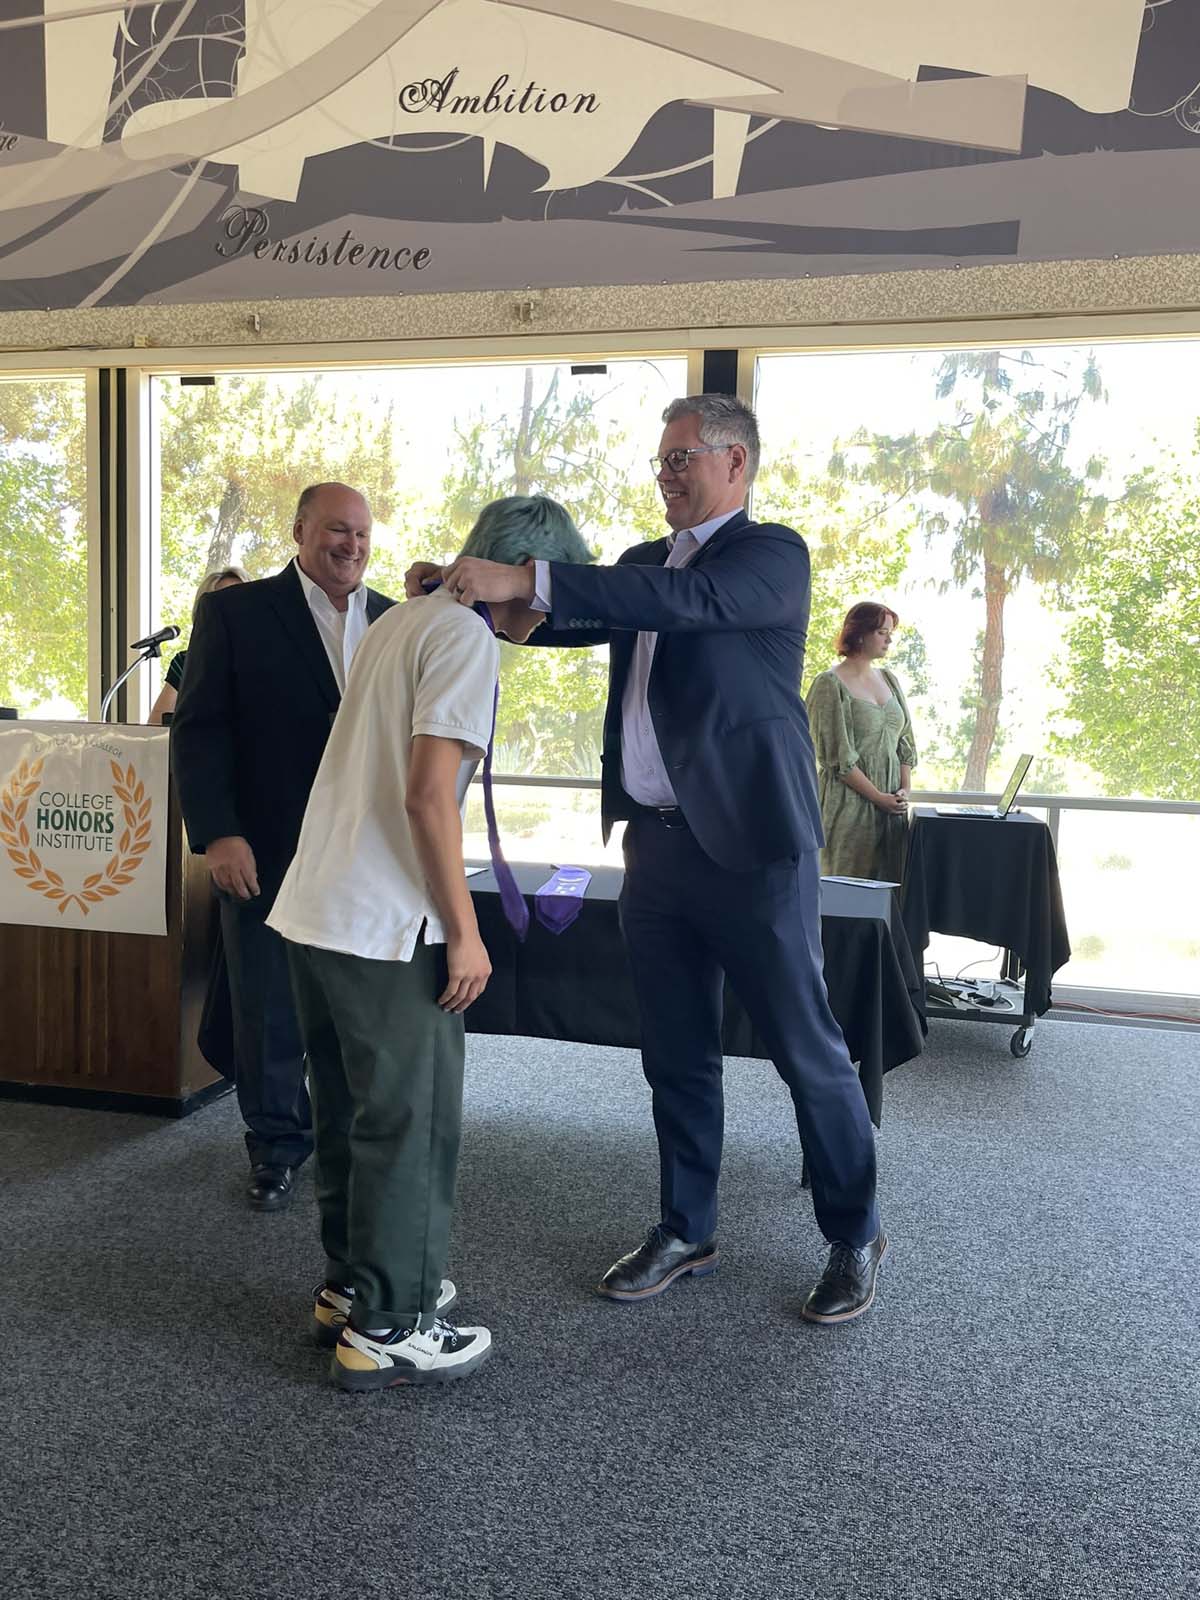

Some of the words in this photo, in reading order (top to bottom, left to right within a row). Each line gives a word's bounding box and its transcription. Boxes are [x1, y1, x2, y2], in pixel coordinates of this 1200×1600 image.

[398, 66, 601, 114] Ambition
[216, 205, 432, 271] Persistence
[39, 791, 113, 810] COLLEGE
[36, 807, 114, 834] HONORS
[36, 831, 113, 852] INSTITUTE
